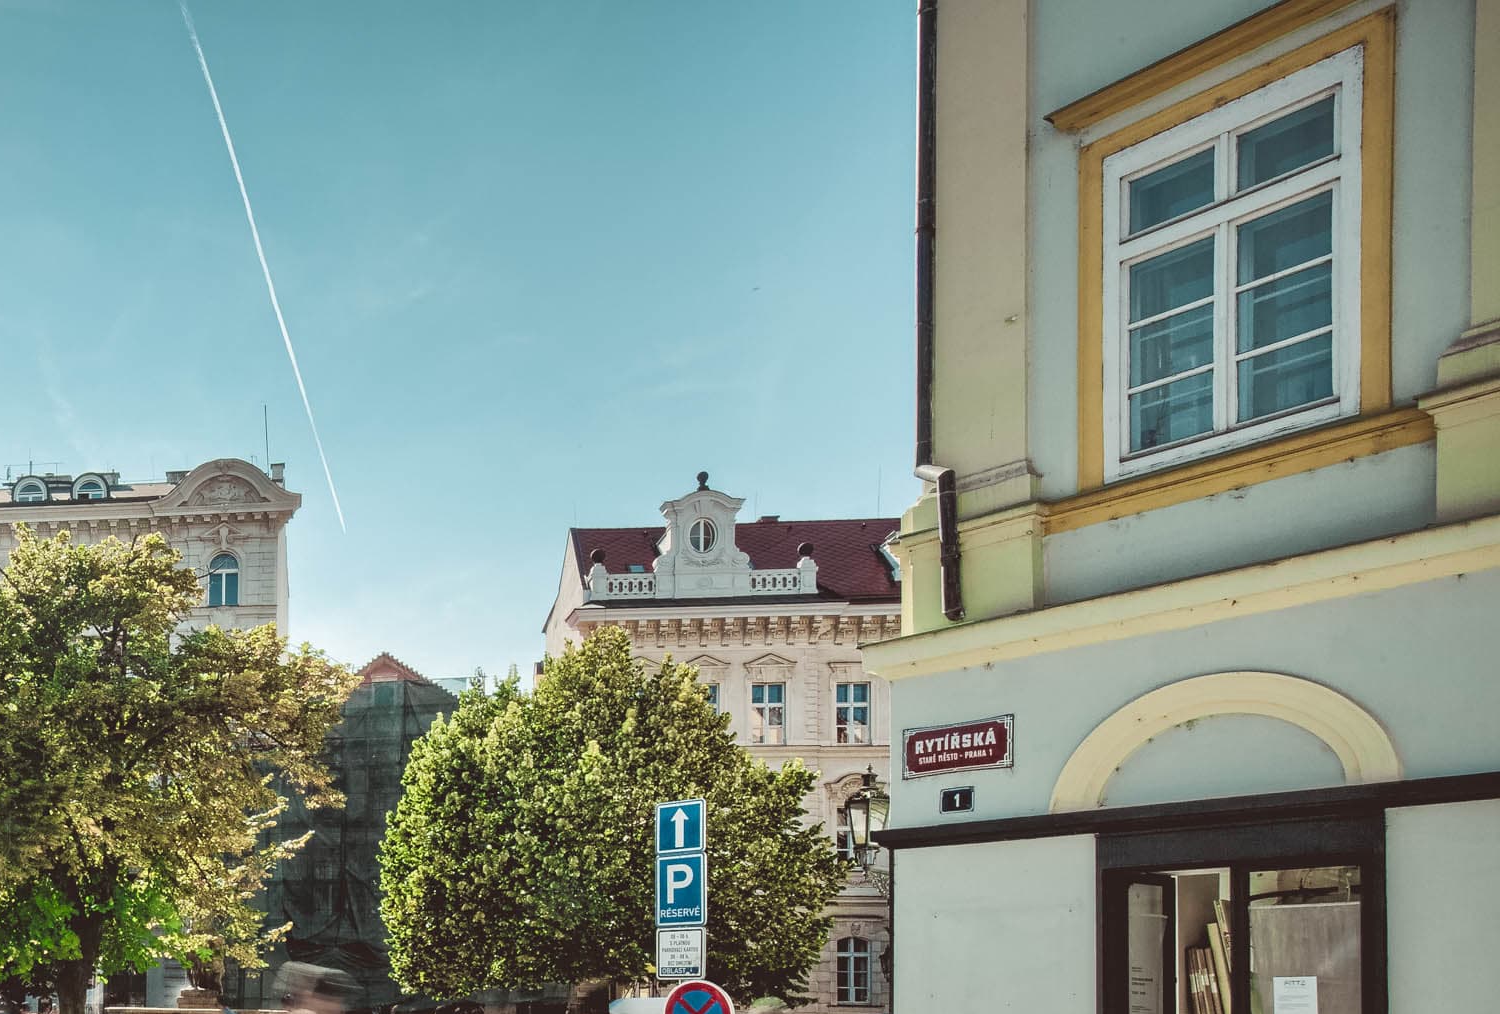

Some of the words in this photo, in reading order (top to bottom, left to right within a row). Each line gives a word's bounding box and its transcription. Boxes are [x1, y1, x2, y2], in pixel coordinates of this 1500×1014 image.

[915, 727, 997, 755] RYTÍŘSKÁ
[938, 752, 959, 763] MĚSTO
[964, 749, 987, 759] PRAHA
[988, 748, 993, 757] 1
[953, 792, 960, 808] 1
[666, 863, 694, 904] P
[660, 905, 701, 918] RÉSERVÉ
